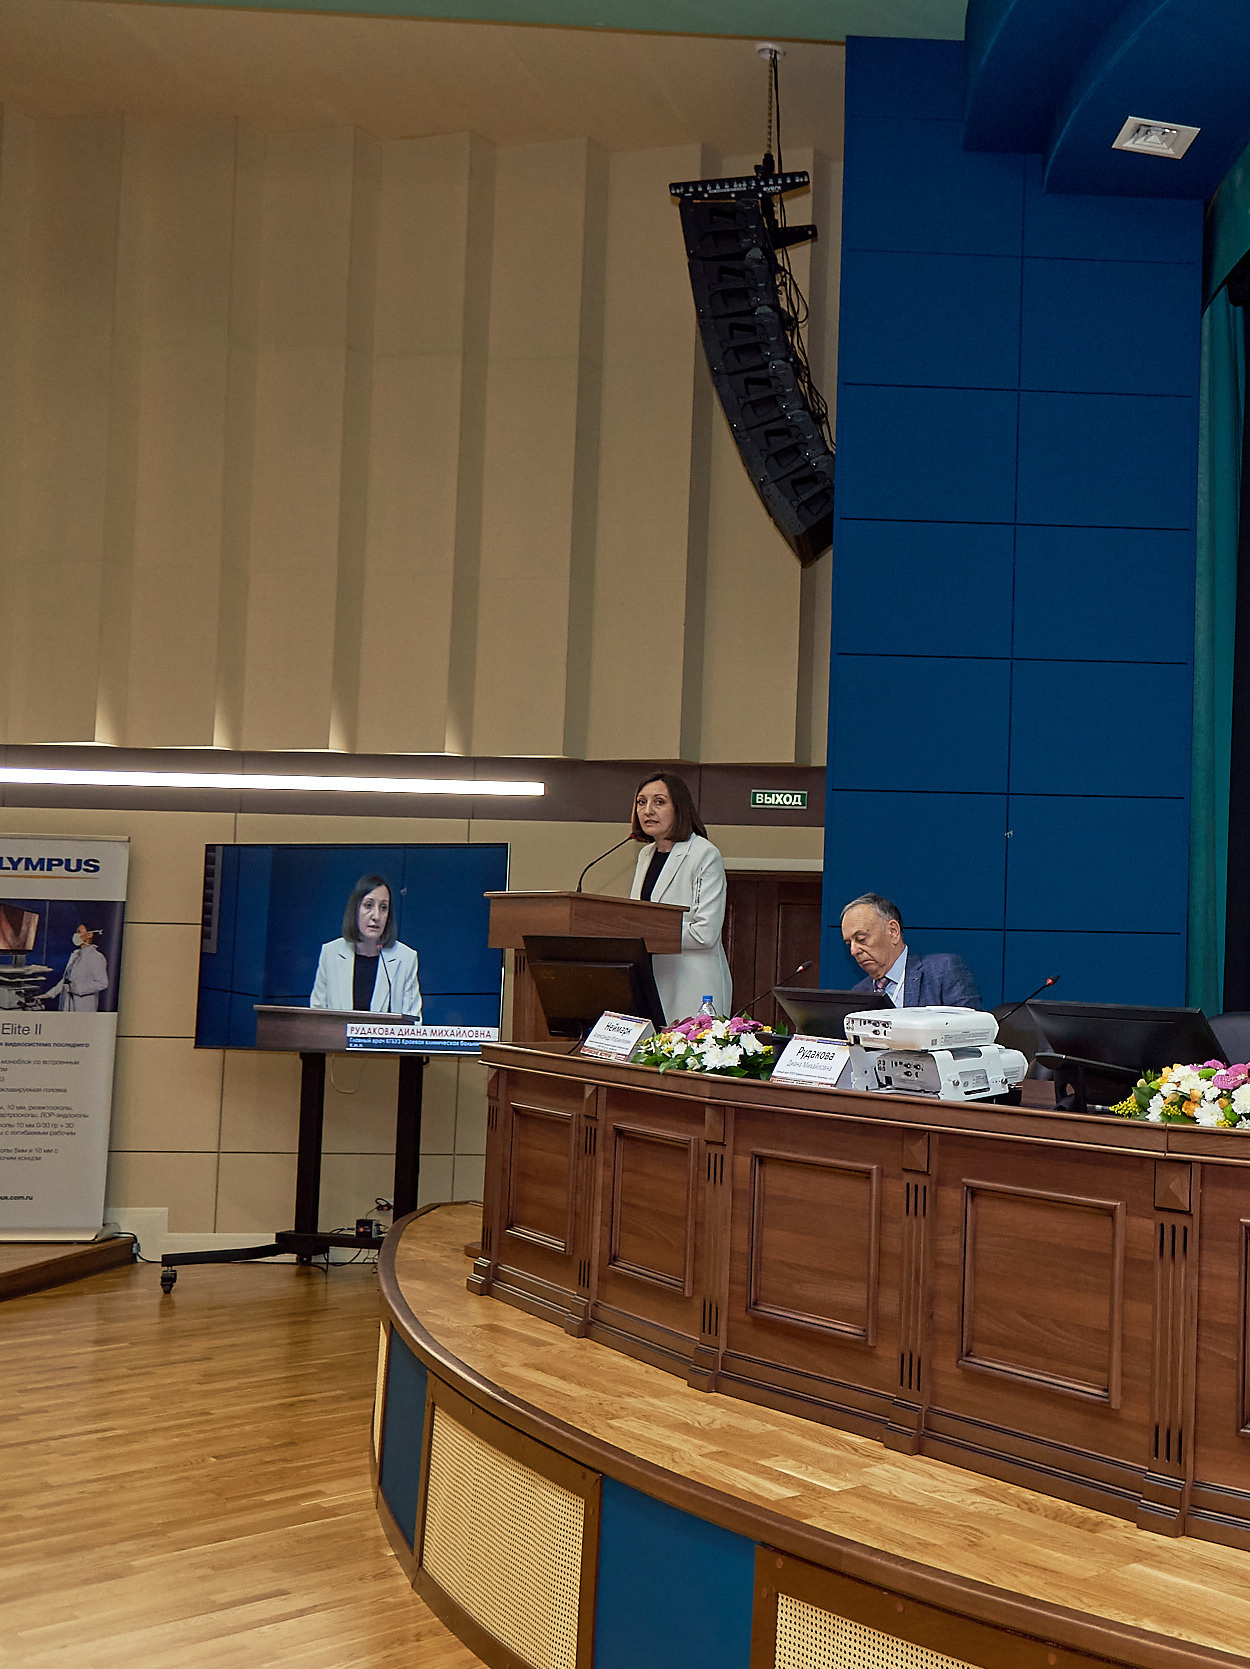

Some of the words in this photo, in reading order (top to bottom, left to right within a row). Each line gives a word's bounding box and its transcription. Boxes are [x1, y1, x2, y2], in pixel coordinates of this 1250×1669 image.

[755, 793, 802, 805] ВЫХОД
[2, 1023, 31, 1036] Elite
[35, 1023, 42, 1035] II
[350, 1026, 395, 1036] РУДАКОВА
[397, 1028, 427, 1037] ДИАНА
[429, 1027, 491, 1039] МИХАЙЛОВНА
[795, 1046, 836, 1061] Рудакова
